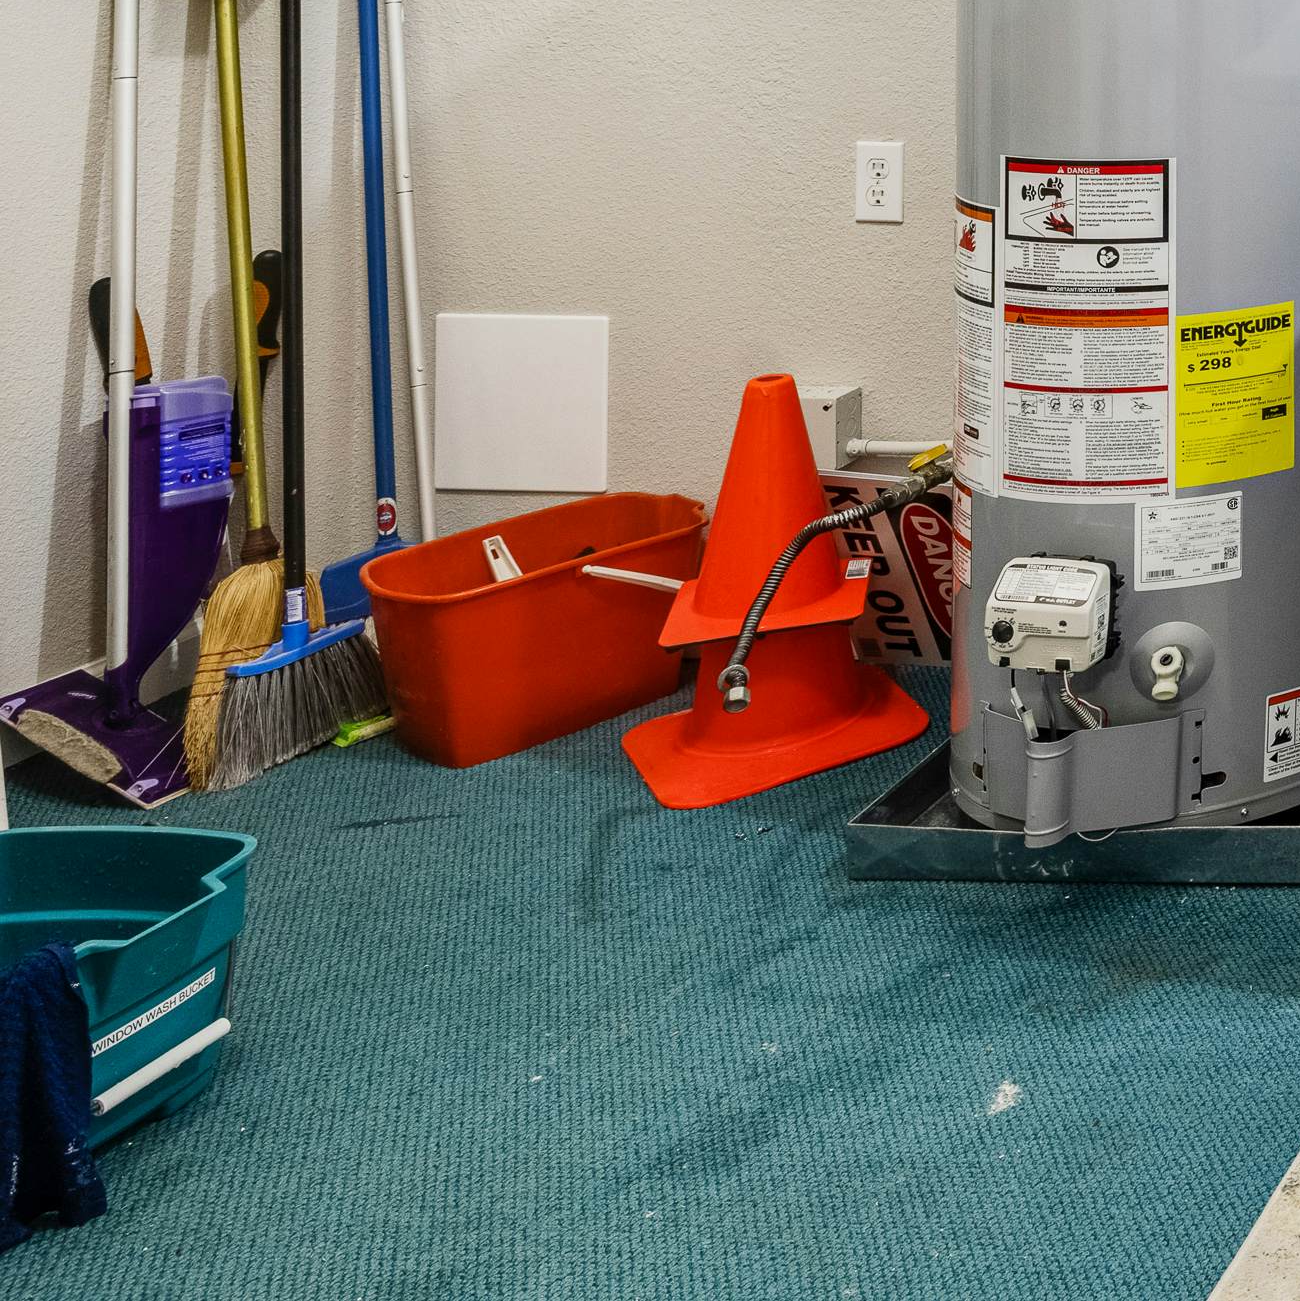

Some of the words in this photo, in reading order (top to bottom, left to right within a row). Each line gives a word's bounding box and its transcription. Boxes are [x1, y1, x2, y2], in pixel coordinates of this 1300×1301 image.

[1181, 314, 1291, 343] ENERGYGUIDE
[1187, 364, 1195, 373] $
[1200, 357, 1232, 371] 298
[910, 516, 954, 617] DANG
[867, 590, 923, 657] OUT
[92, 1018, 143, 1055] WINDOW
[146, 997, 177, 1022] WASH
[179, 970, 214, 1001] BUCKET
